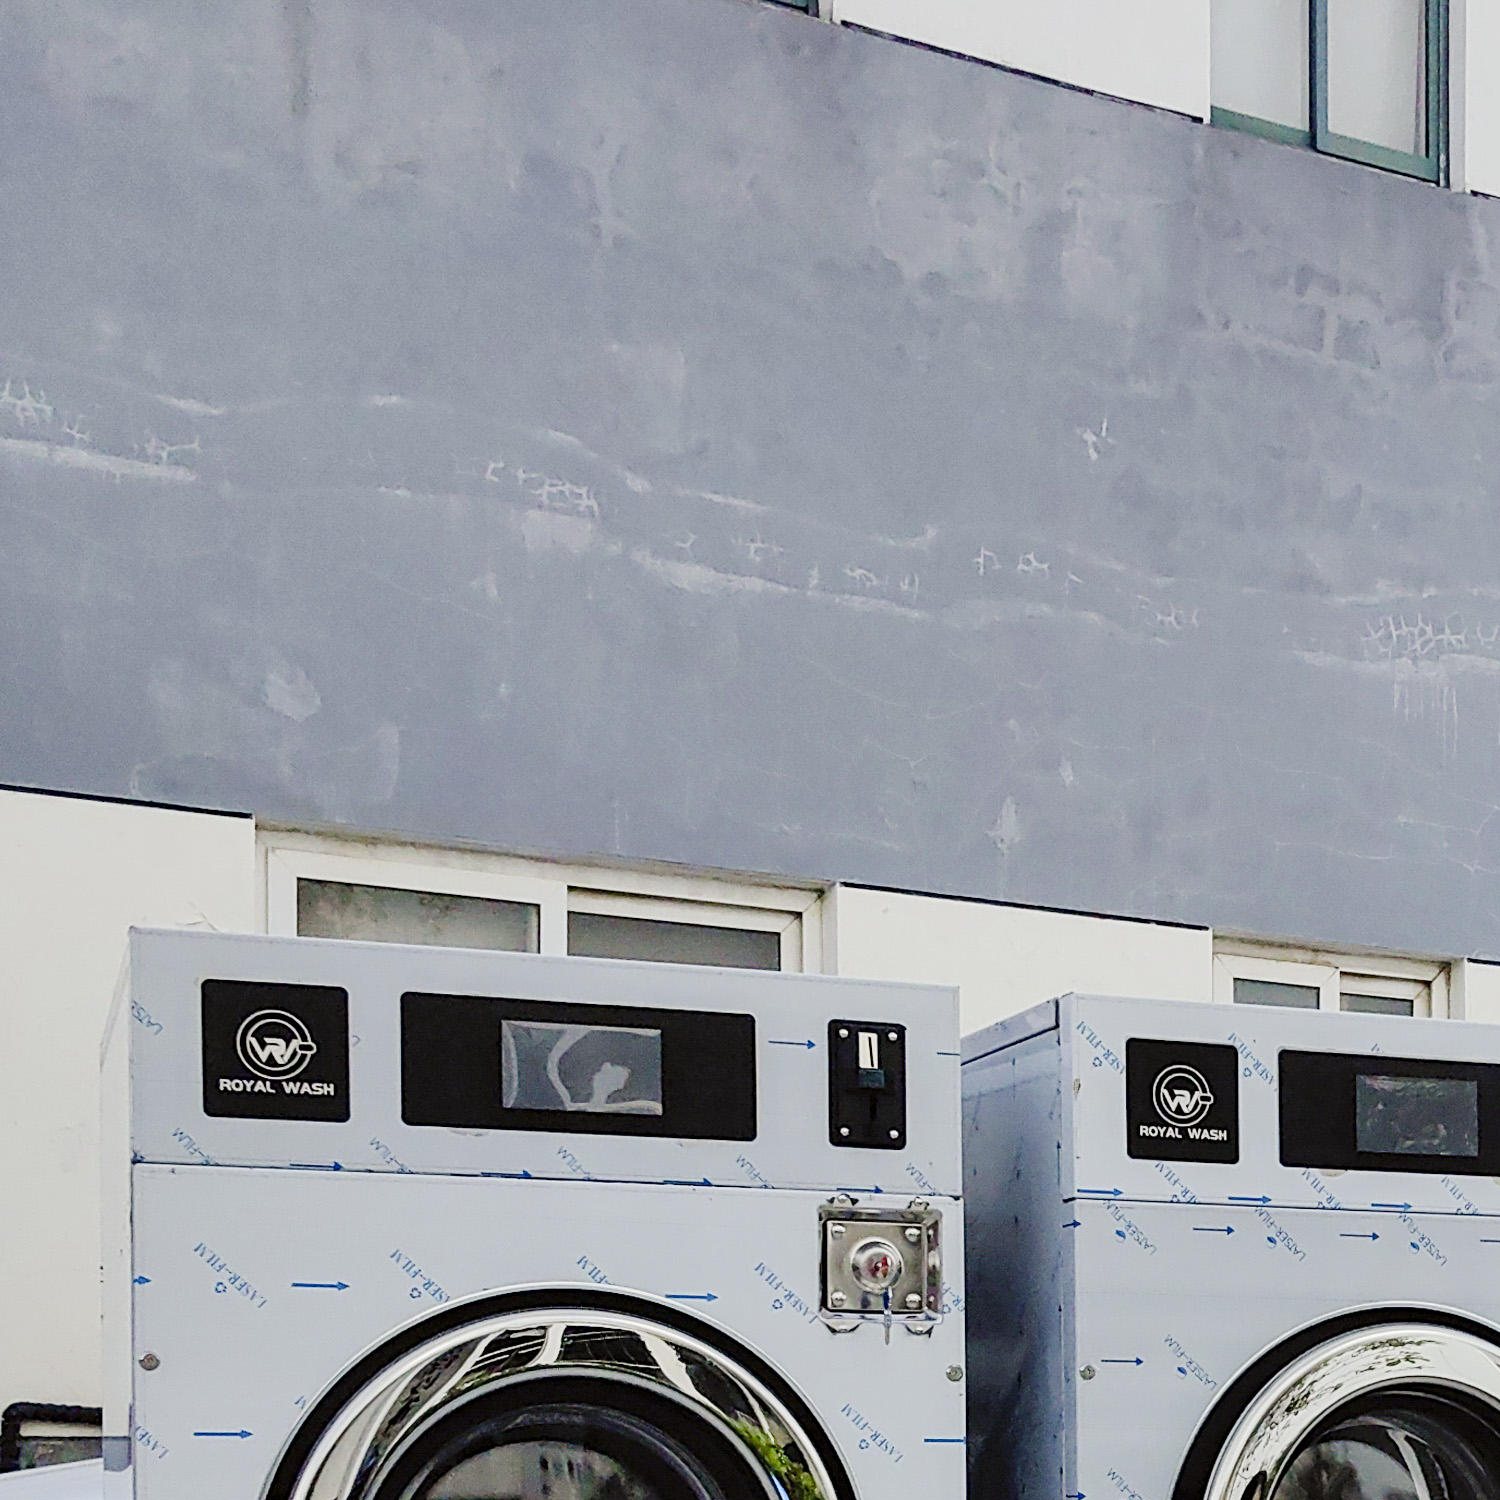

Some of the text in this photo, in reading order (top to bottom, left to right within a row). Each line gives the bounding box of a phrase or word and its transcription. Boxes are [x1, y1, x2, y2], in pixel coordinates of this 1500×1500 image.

[219, 1079, 335, 1096] ROYAL WASH
[1140, 1125, 1227, 1141] ROYAL WASH
